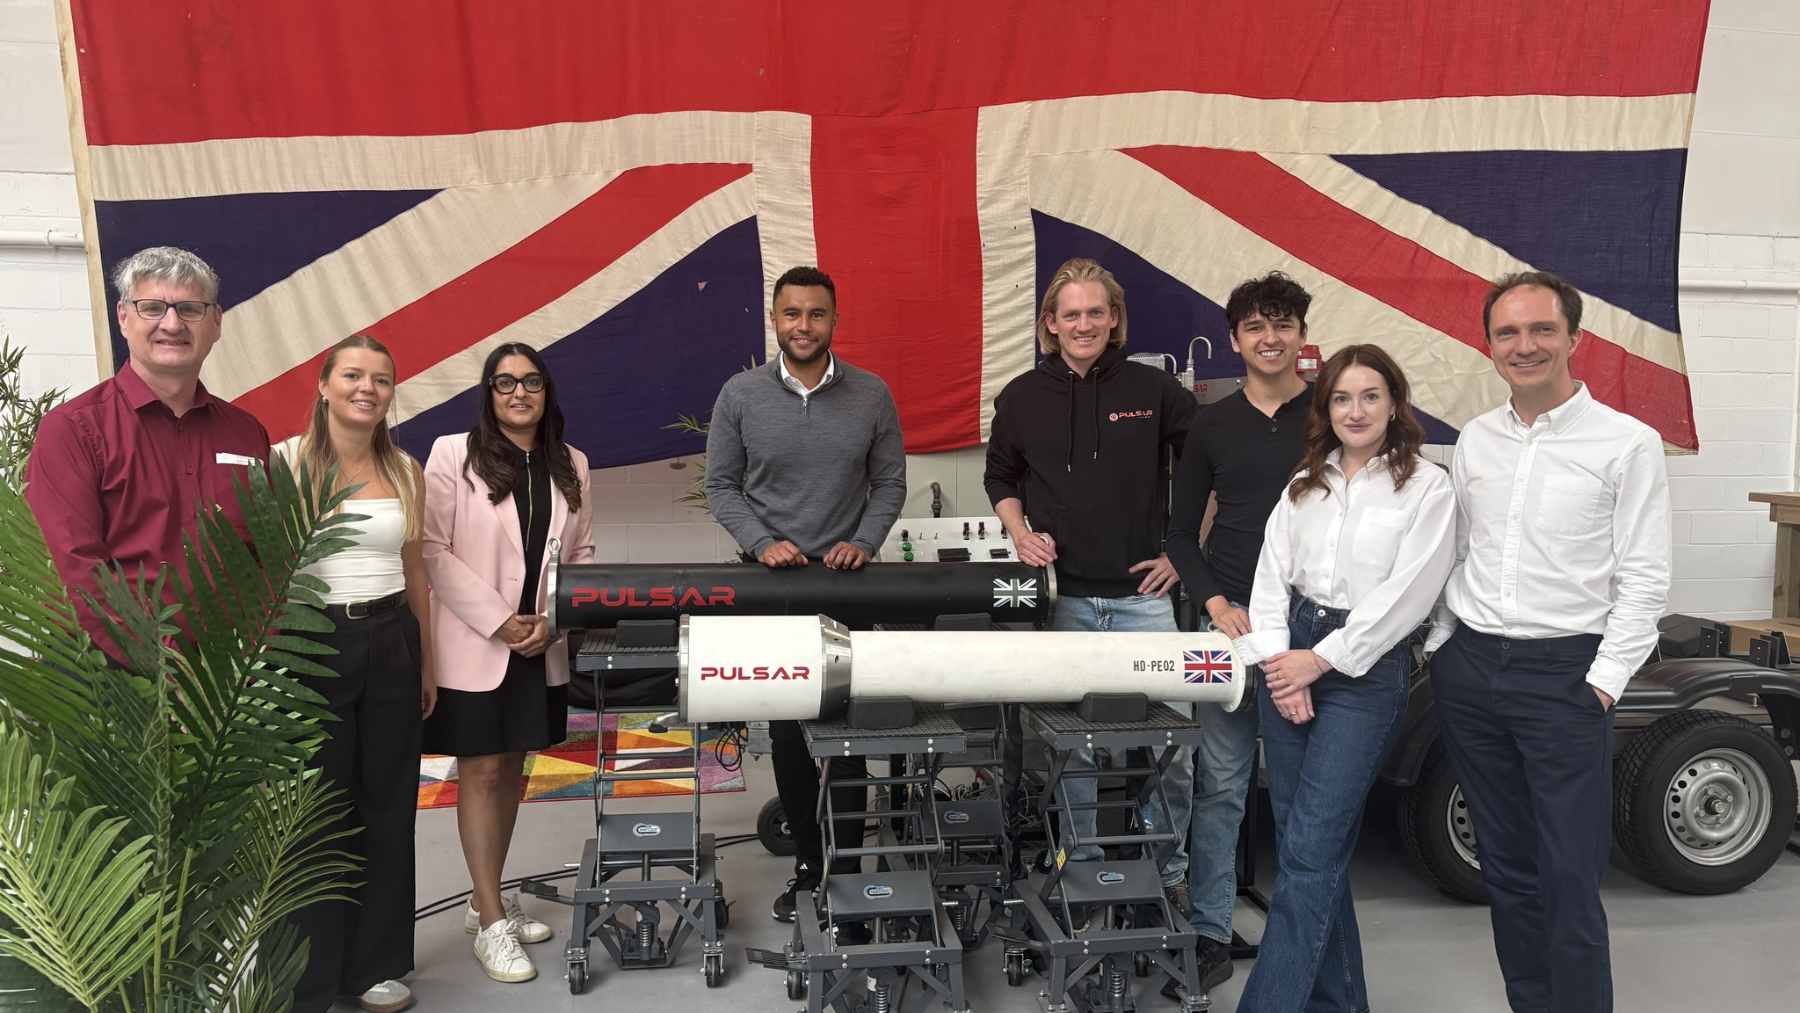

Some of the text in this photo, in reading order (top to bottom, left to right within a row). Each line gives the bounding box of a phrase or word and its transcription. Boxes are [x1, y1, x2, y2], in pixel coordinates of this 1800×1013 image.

[571, 586, 736, 608] PULSAR
[700, 665, 810, 681] PULSAR
[1133, 660, 1175, 672] HD-PE02
